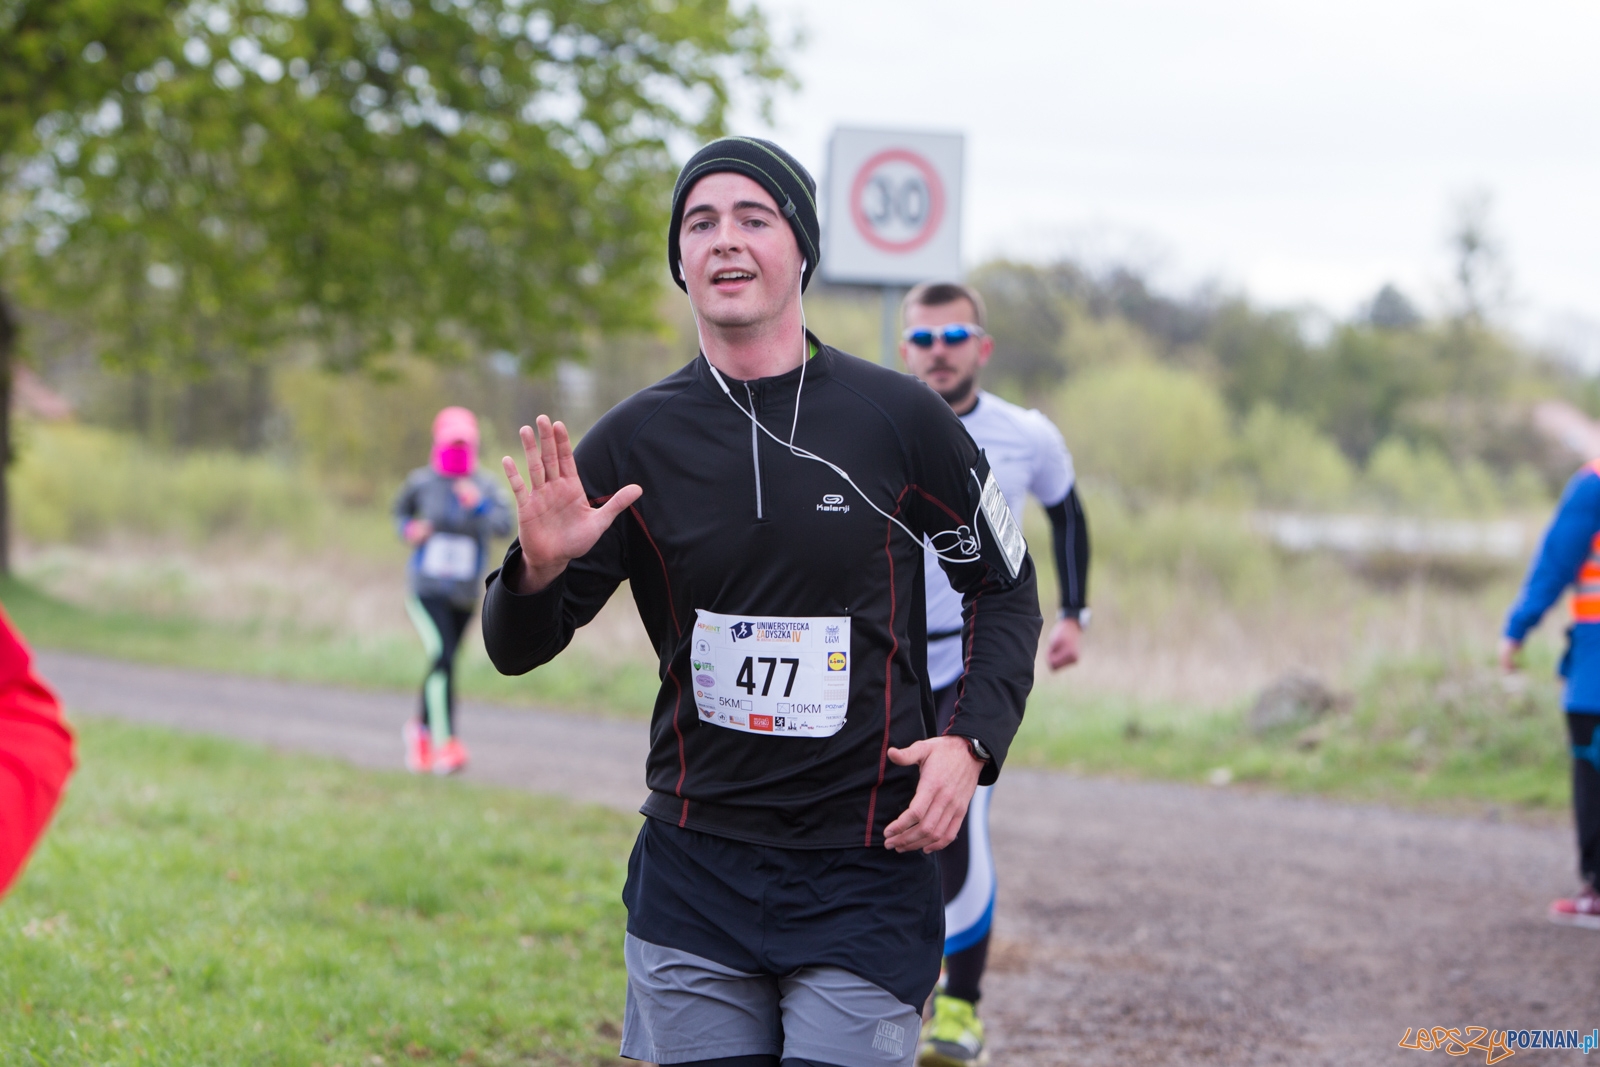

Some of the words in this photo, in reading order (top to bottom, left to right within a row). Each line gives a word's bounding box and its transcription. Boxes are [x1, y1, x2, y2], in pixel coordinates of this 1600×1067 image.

[863, 176, 930, 228] 30
[816, 504, 850, 514] Kalenji
[757, 622, 810, 631] UNIWERSYTECKA
[757, 630, 791, 639] ZADYSZKA
[792, 631, 802, 643] IV
[736, 656, 799, 697] 477
[719, 696, 740, 709] 5KM
[791, 703, 822, 714] 10KM
[878, 1020, 896, 1038] KEEP
[871, 1035, 903, 1056] RUNNING
